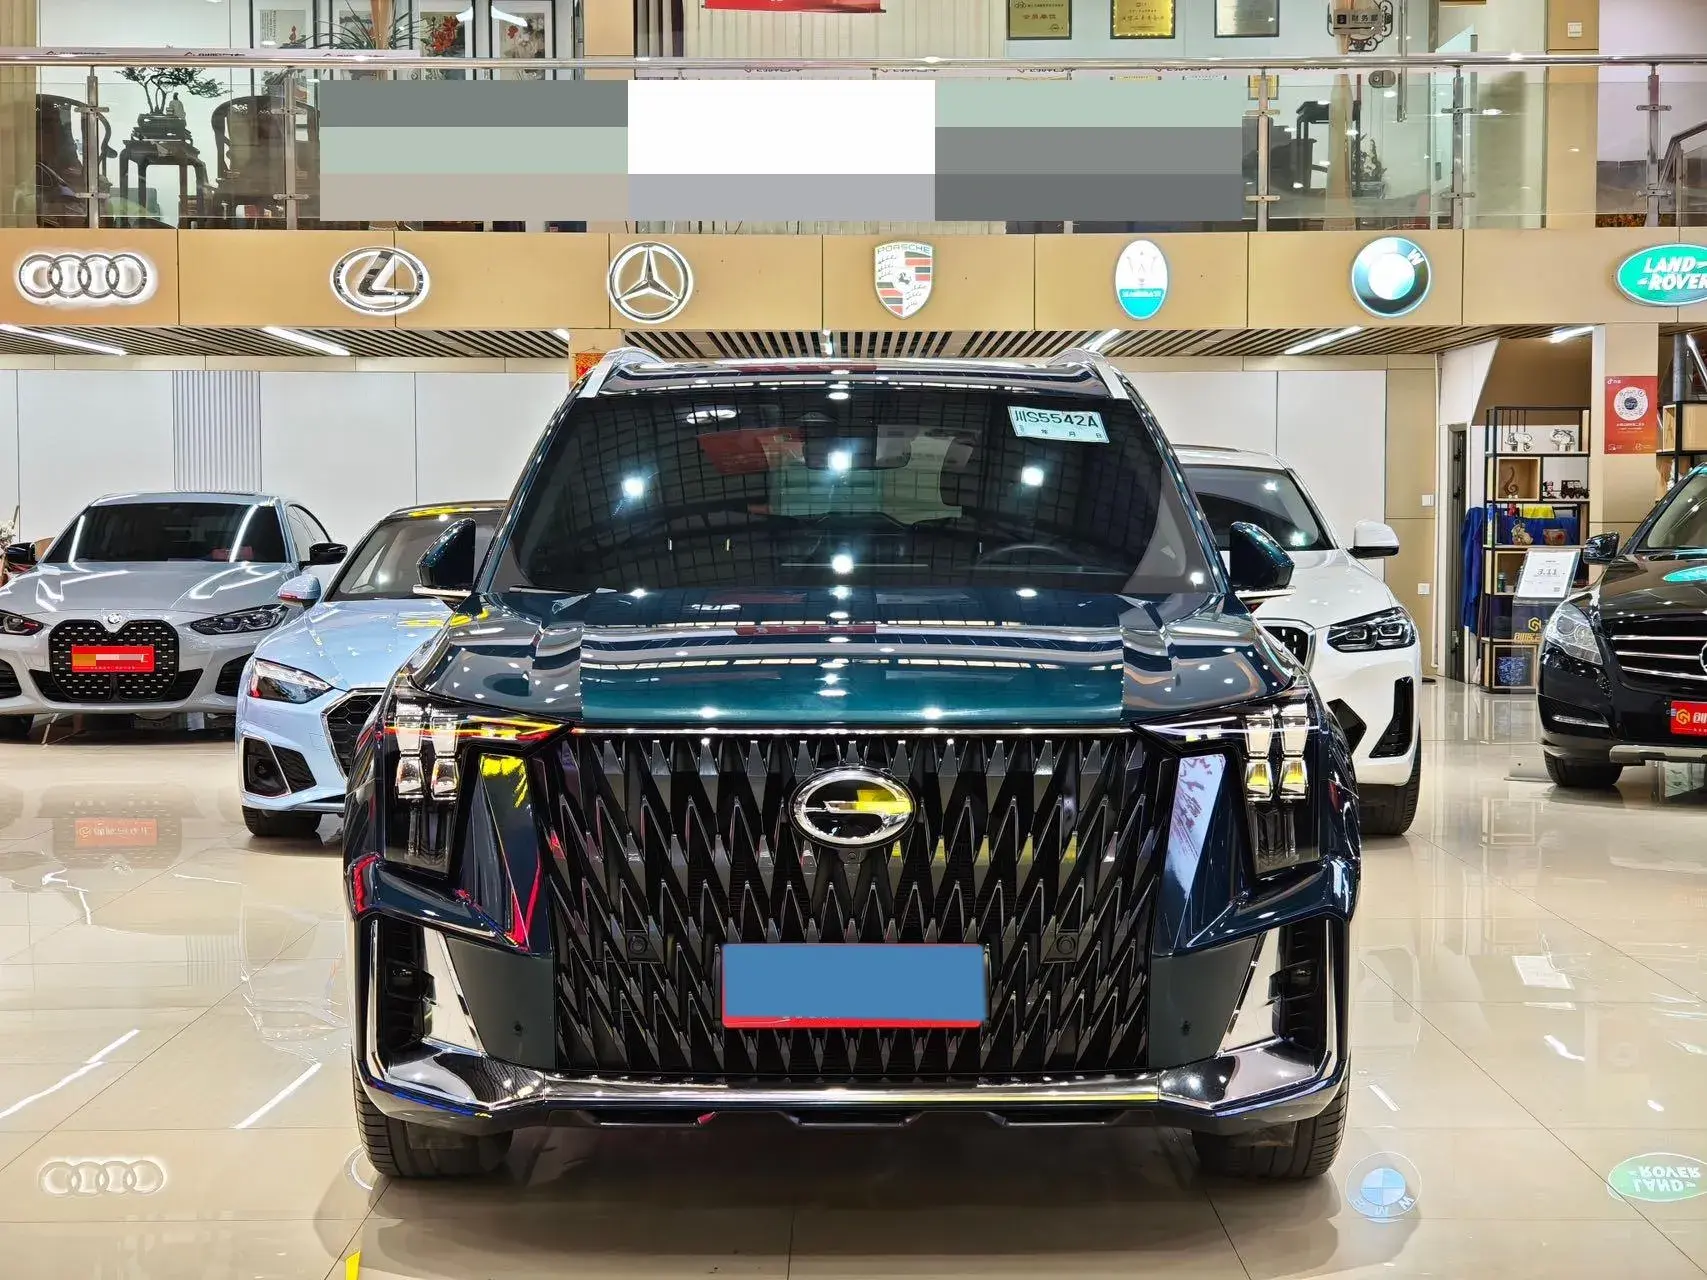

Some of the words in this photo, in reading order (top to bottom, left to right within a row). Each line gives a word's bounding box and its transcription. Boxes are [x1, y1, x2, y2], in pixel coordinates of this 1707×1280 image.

[877, 243, 931, 254] PORSCHE
[1643, 255, 1696, 273] LAND
[1014, 410, 1099, 427] 川S5542A
